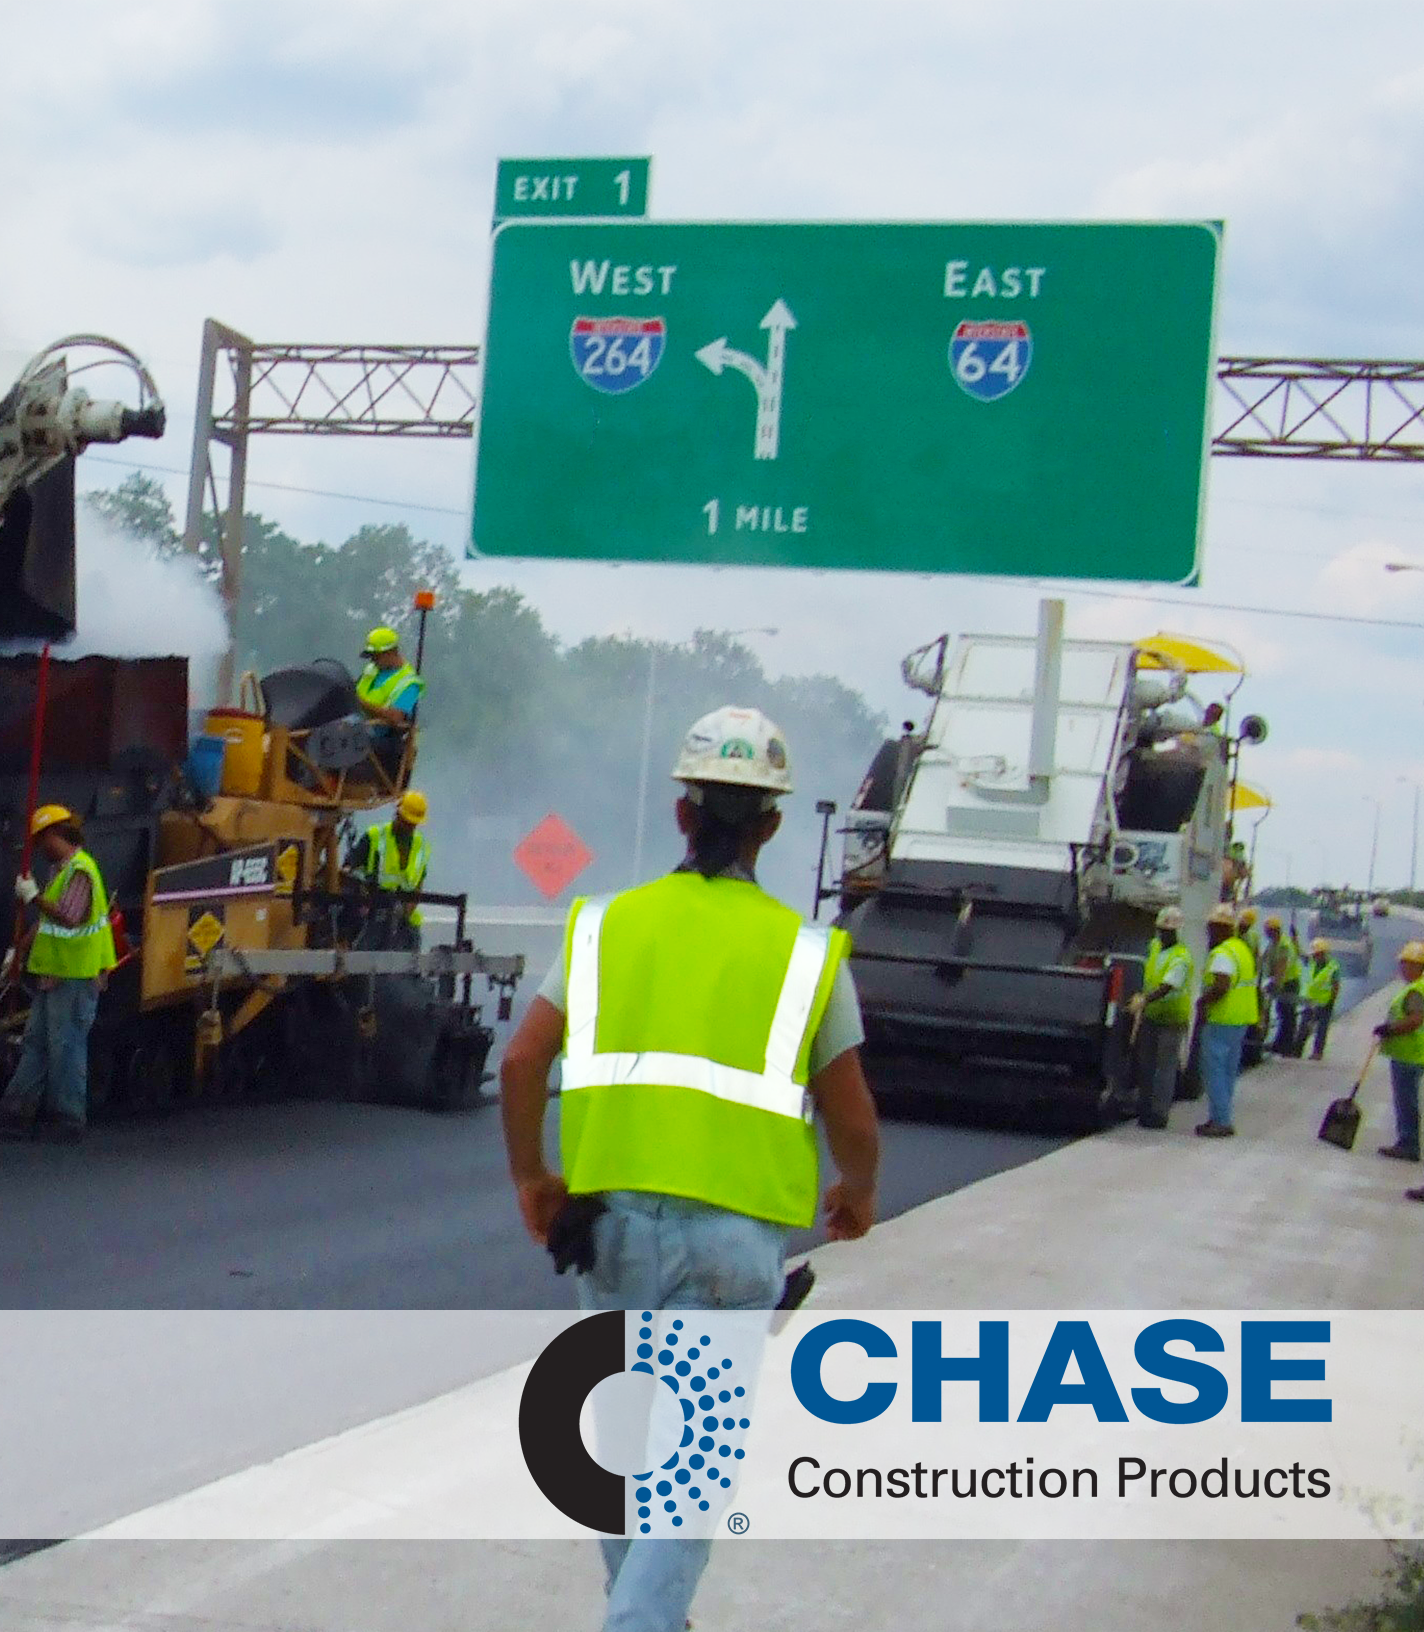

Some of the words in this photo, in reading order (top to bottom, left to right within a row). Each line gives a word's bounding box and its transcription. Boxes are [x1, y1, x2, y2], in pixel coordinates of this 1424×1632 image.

[514, 175, 578, 201] EXIT
[613, 169, 631, 205] 1
[570, 259, 677, 295] WEST
[943, 260, 1046, 298] EAST
[582, 336, 651, 376] 264
[956, 340, 1022, 382] 64
[702, 498, 719, 535] 1
[735, 505, 809, 533] MILE
